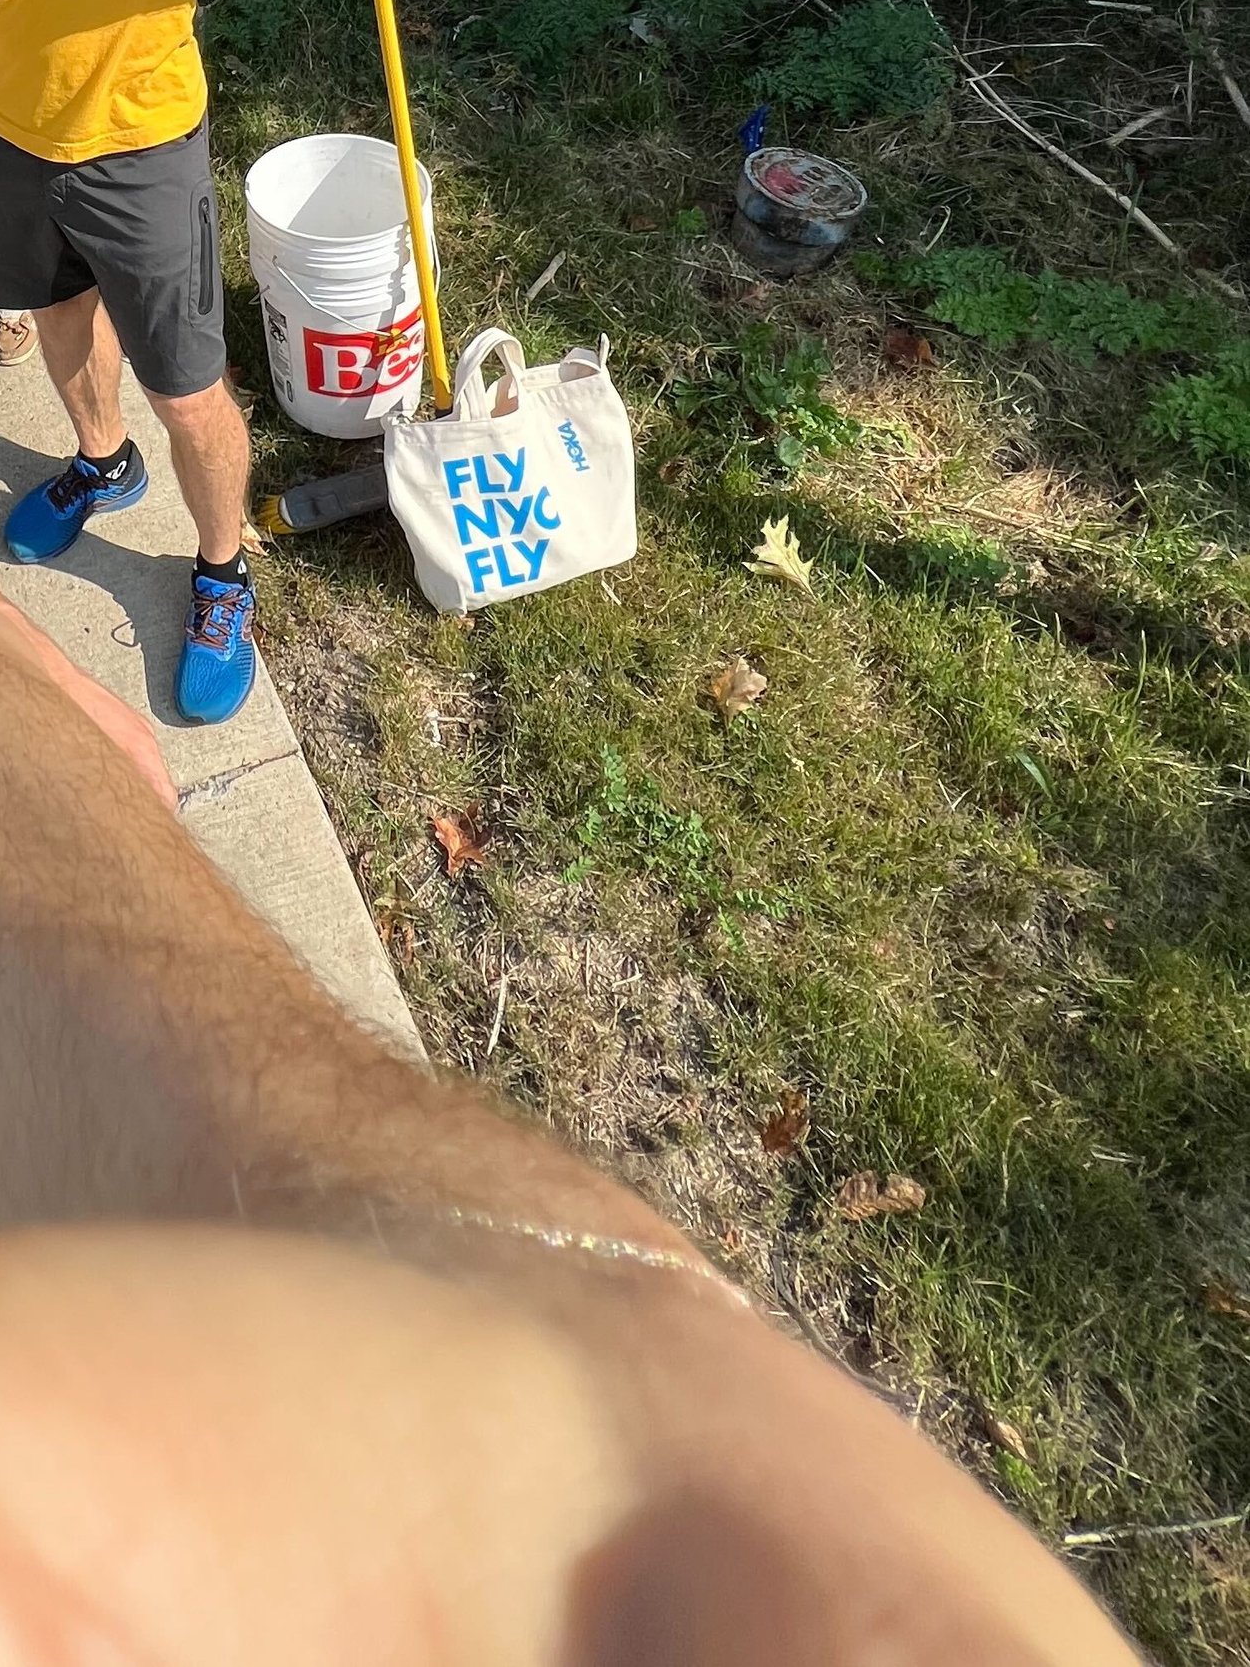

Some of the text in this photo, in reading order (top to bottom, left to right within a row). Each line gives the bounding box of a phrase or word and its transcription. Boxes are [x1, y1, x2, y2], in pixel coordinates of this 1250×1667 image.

[442, 446, 525, 499] FLY
[558, 420, 590, 472] HOKA
[452, 486, 562, 546] NYC
[465, 538, 550, 594] FLY
